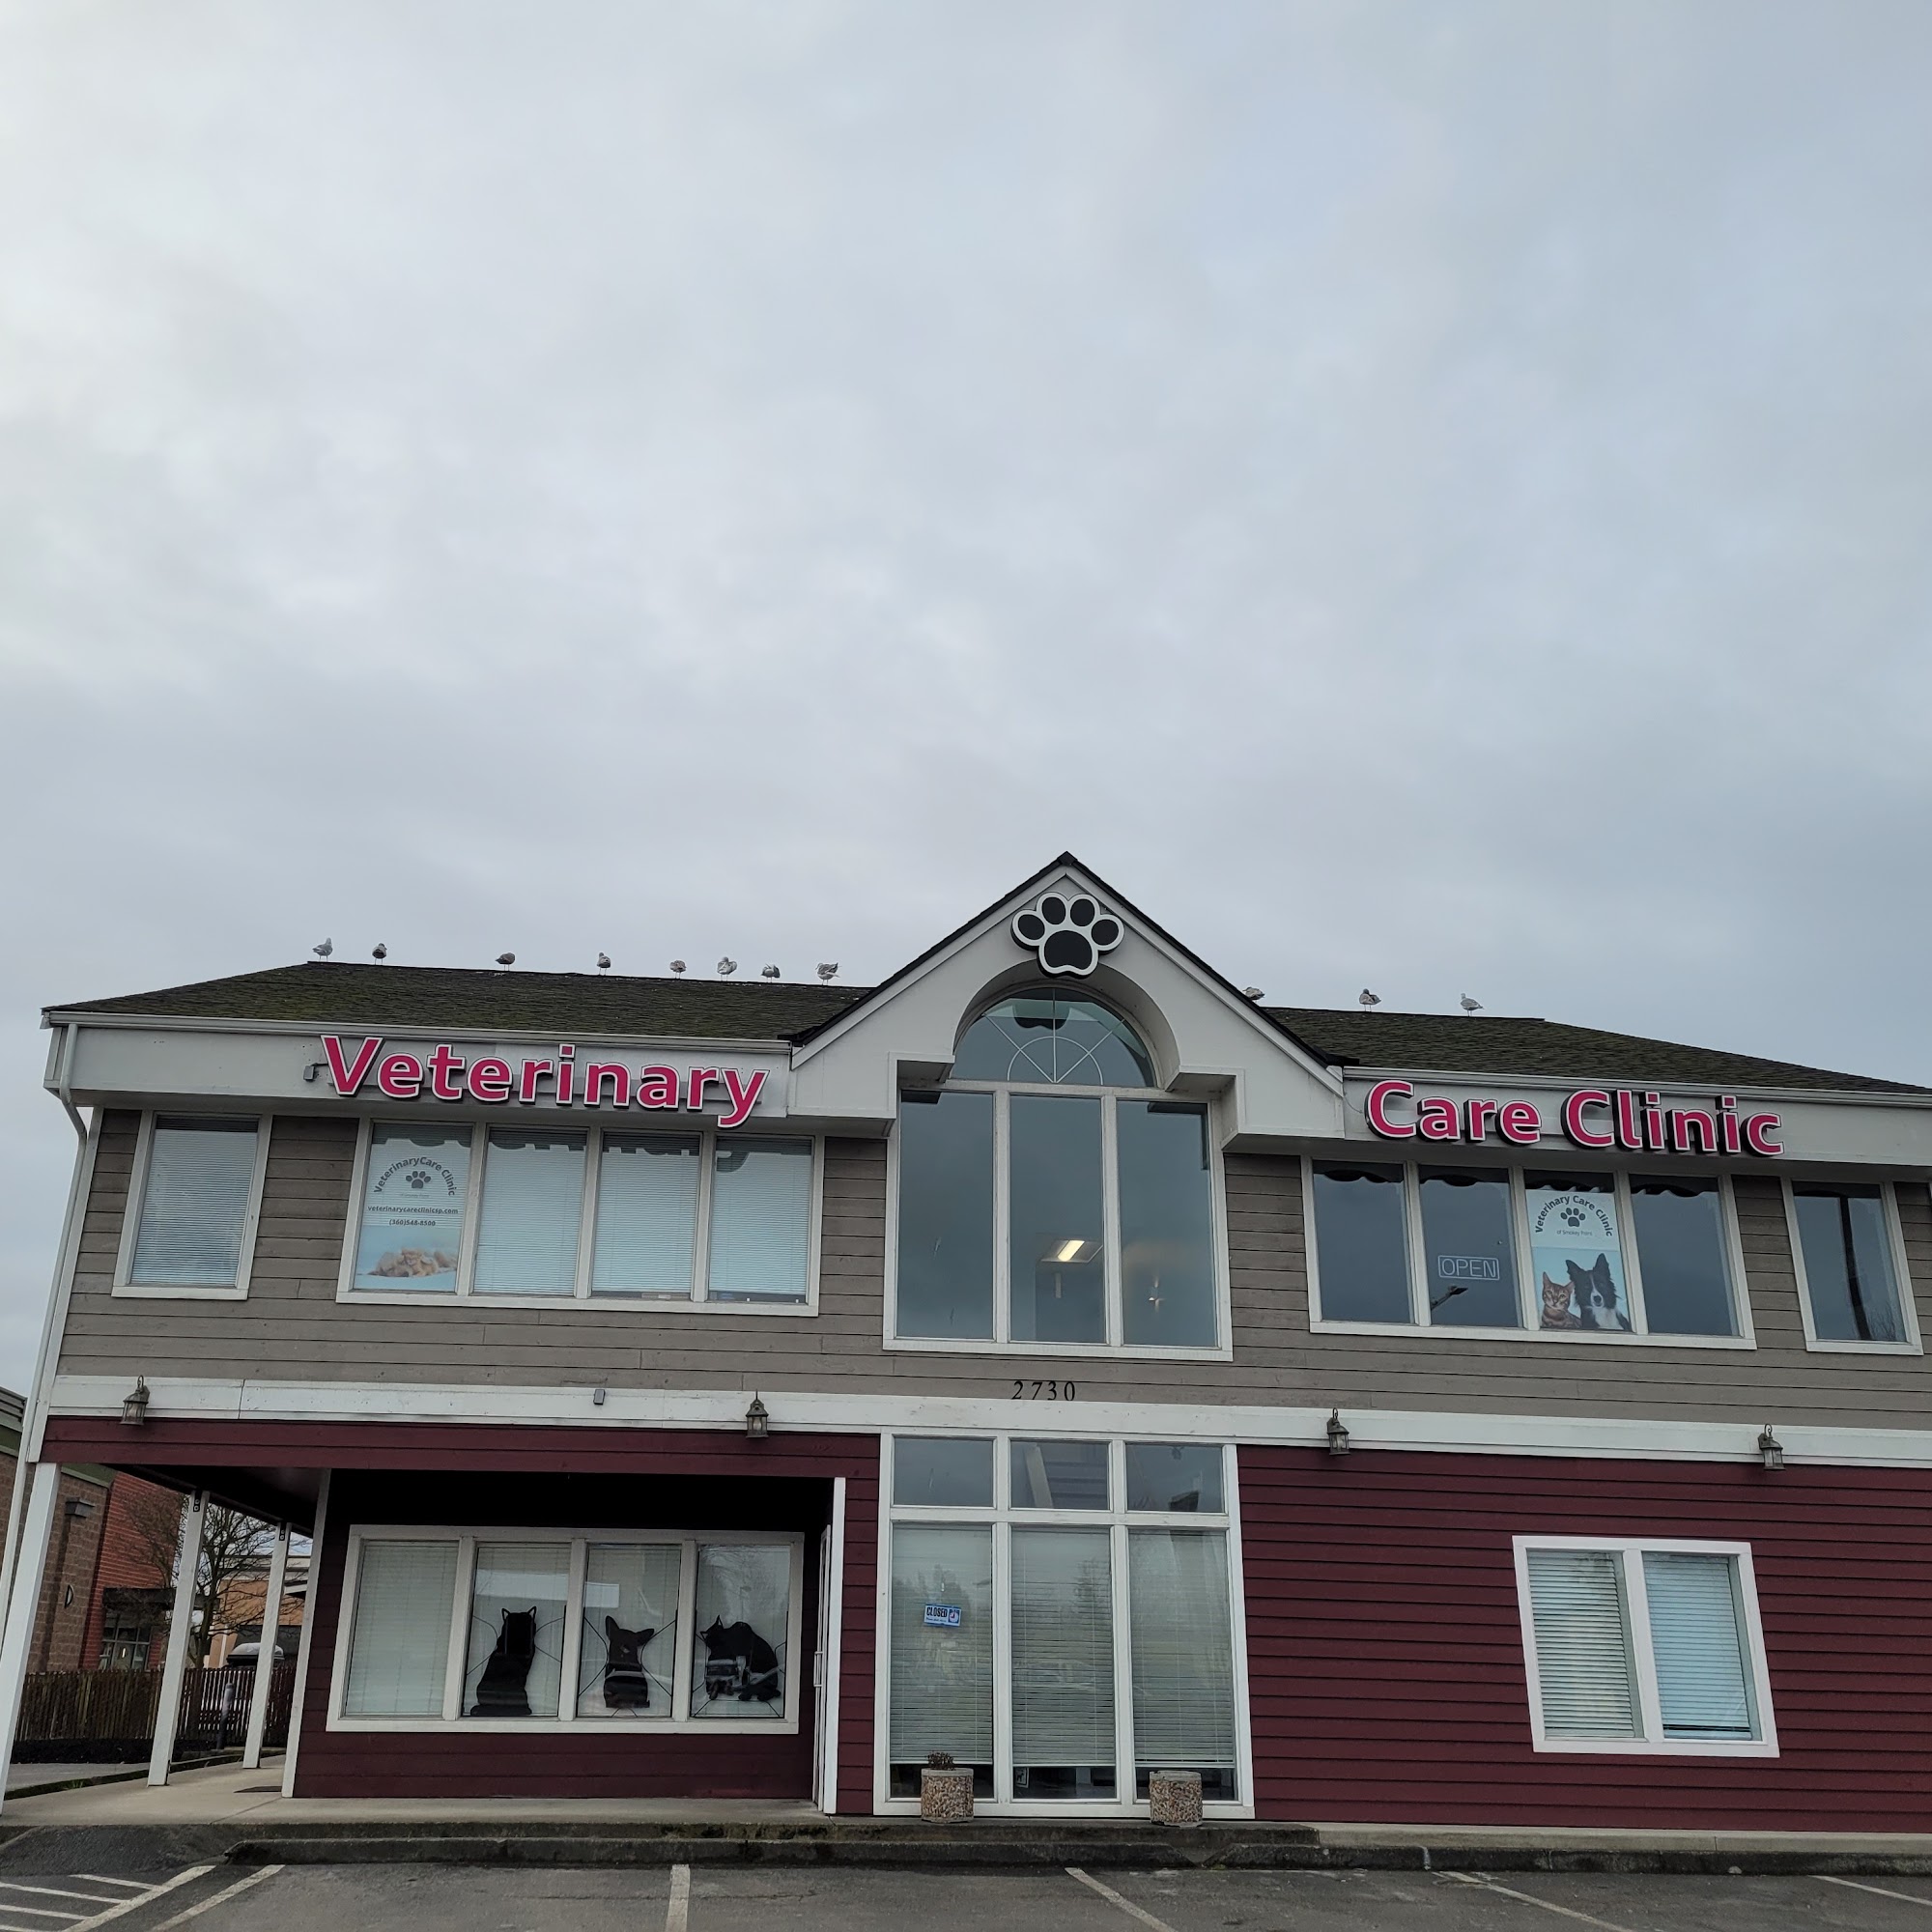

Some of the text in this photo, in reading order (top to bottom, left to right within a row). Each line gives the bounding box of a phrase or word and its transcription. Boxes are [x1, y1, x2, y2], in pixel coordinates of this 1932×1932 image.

[320, 1035, 770, 1128] Veterinary
[1366, 1080, 1785, 1156] Care Clinic
[440, 1169, 457, 1197] Clinic
[367, 1206, 459, 1214] veterinarycareclinicsp.com
[1535, 1195, 1613, 1236] Veterinary Care Clinic
[1442, 1259, 1496, 1277] OPEN
[1011, 1380, 1076, 1401] 2730
[926, 1606, 948, 1618] CLOSED
